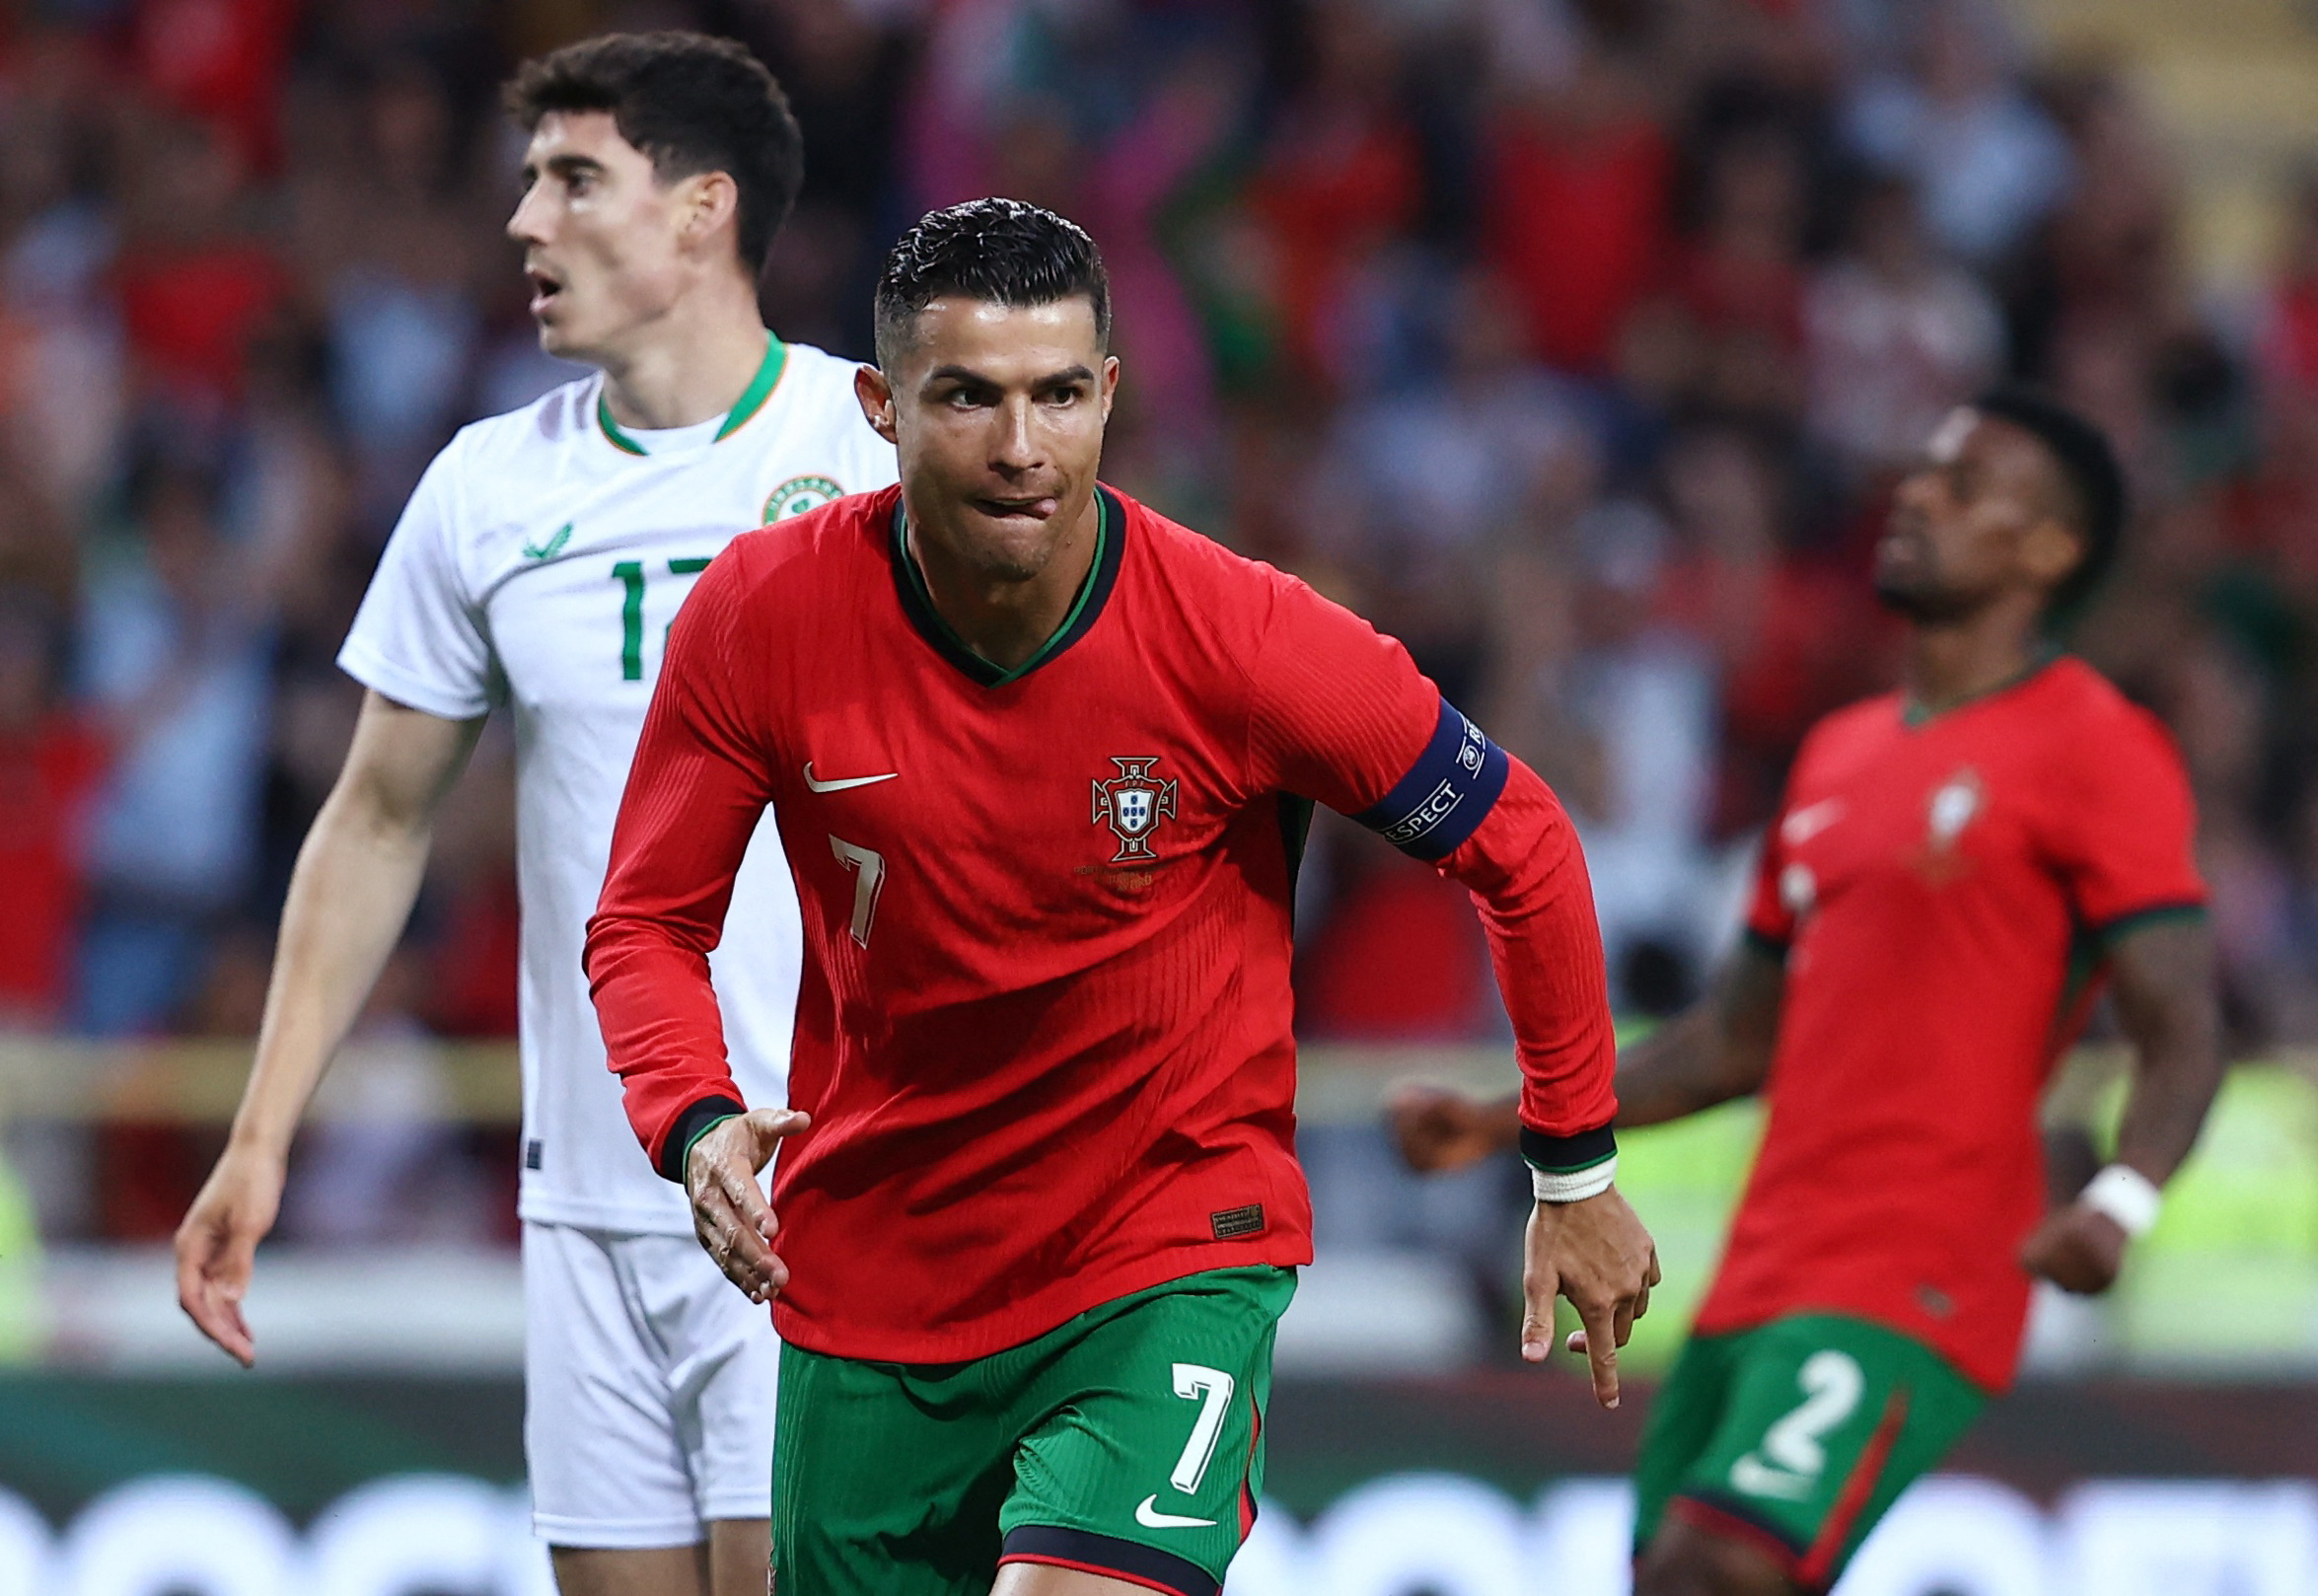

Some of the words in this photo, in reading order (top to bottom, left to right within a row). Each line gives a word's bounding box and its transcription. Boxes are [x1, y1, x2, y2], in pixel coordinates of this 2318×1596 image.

[612, 558, 712, 681] 1
[1385, 782, 1457, 839] ESPECT
[829, 833, 885, 950] 7
[1170, 1363, 1234, 1495] 7
[1763, 1349, 1864, 1476] 2
